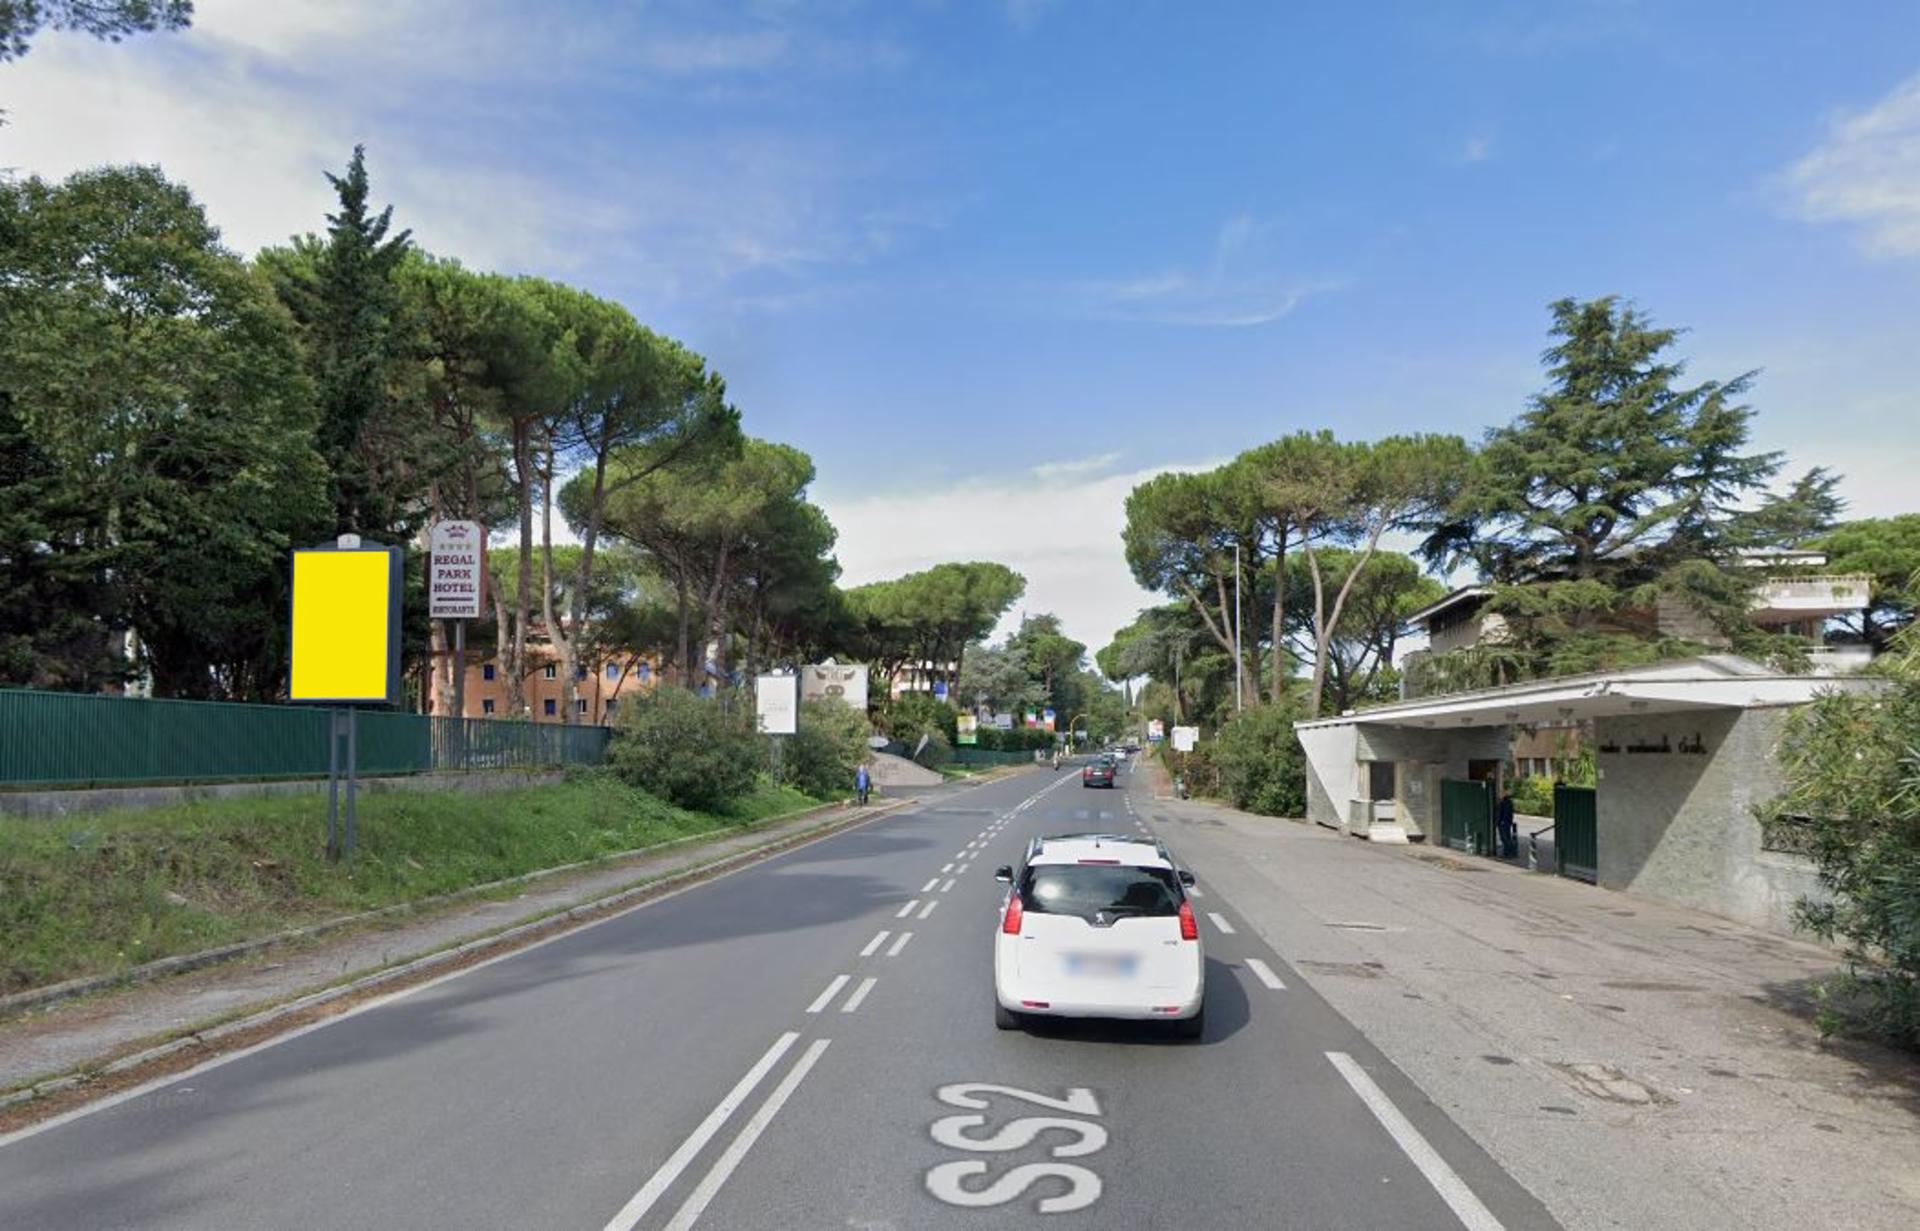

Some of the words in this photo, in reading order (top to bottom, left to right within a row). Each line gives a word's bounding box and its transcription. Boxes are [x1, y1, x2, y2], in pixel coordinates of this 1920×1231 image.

[434, 555, 475, 565] REGAL
[437, 569, 472, 579] PARK
[433, 583, 475, 593] HOTEL
[926, 1082, 1108, 1213] SS2
